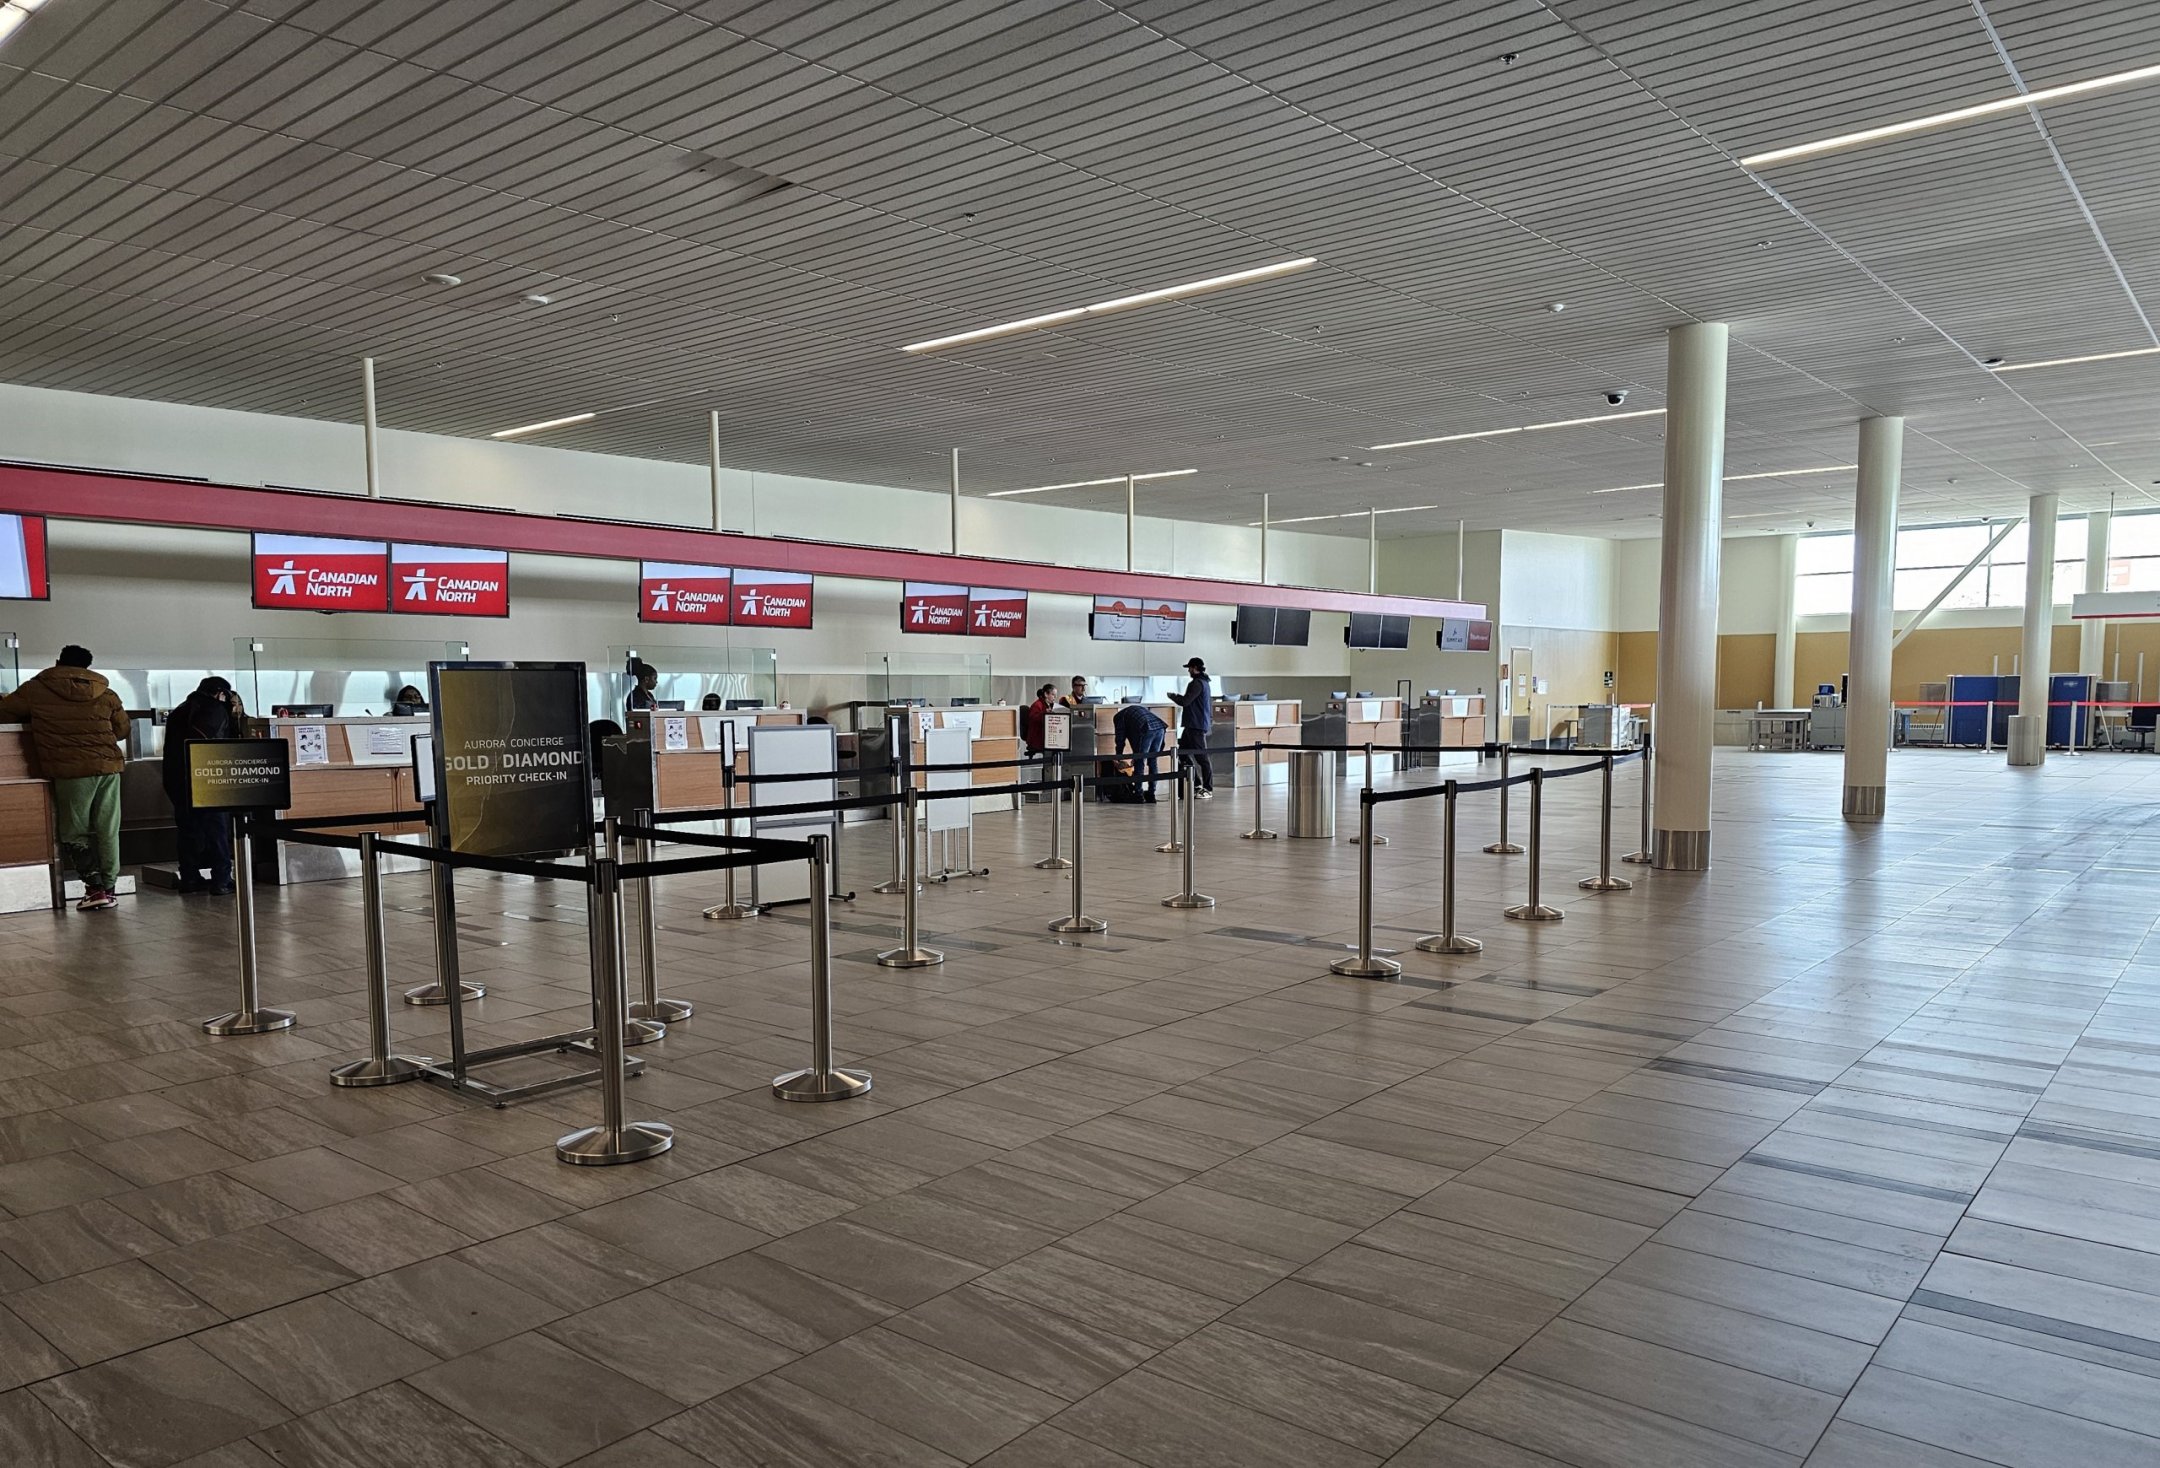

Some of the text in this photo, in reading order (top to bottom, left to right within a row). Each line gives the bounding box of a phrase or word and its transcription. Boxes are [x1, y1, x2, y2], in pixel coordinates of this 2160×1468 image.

[308, 569, 378, 585] CANADIAN
[305, 582, 353, 597] NORTH
[437, 576, 499, 592] CANADIAN
[435, 589, 477, 603] NORTH
[677, 590, 724, 603] CANADIAN
[764, 595, 806, 608] CANADIAN
[675, 601, 707, 613] NORTH
[762, 605, 791, 617] NORTH
[930, 605, 963, 616] CANADIAN
[928, 615, 950, 625] NORTH
[991, 609, 1022, 620] CANADIAN
[990, 618, 1011, 628] NORTH
[464, 737, 564, 750] AURORA CONCIERGE
[445, 751, 583, 771] GOLD DIAMOND
[194, 766, 280, 777] GOLD DIAMOND
[466, 771, 567, 786] PRIORITY CHECK-IN
